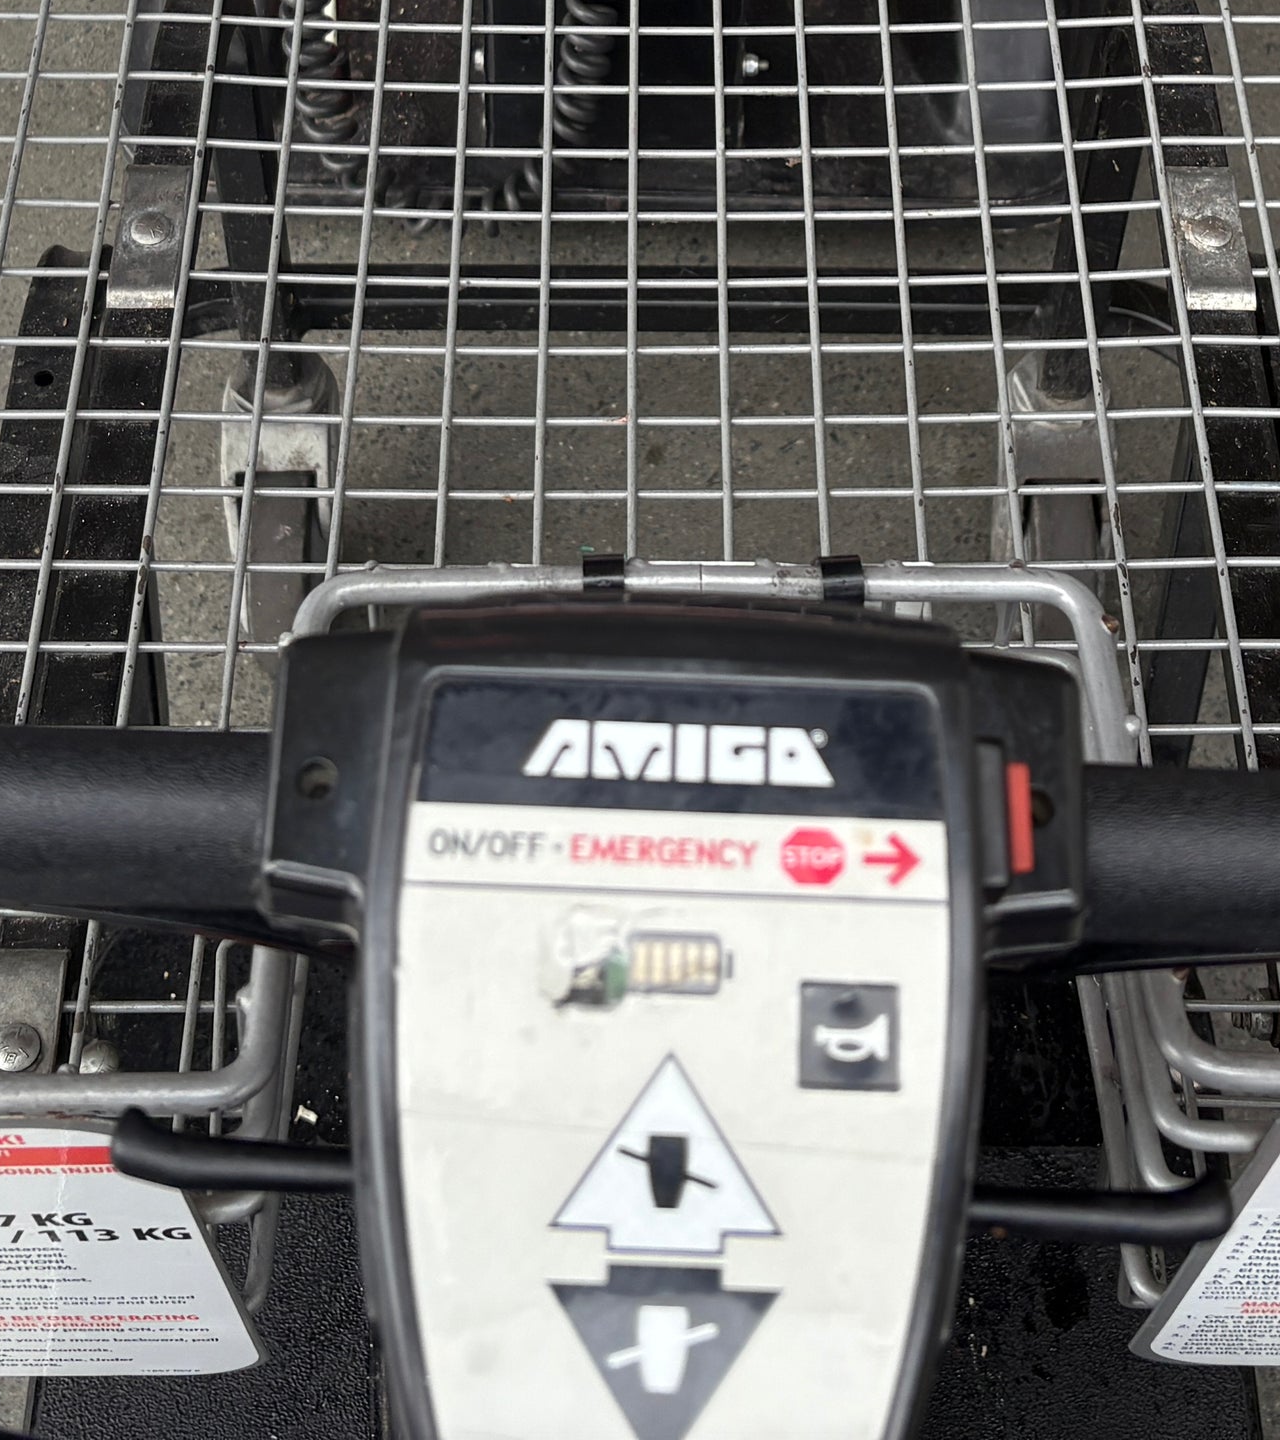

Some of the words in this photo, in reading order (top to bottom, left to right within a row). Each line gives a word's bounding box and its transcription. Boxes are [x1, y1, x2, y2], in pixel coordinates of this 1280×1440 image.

[427, 828, 546, 858] ON/OFF
[569, 833, 760, 868] EMERGENCY
[782, 844, 844, 870] STOP
[31, 1213, 94, 1227] KG
[38, 1229, 120, 1242] 113
[132, 1227, 192, 1241] KG
